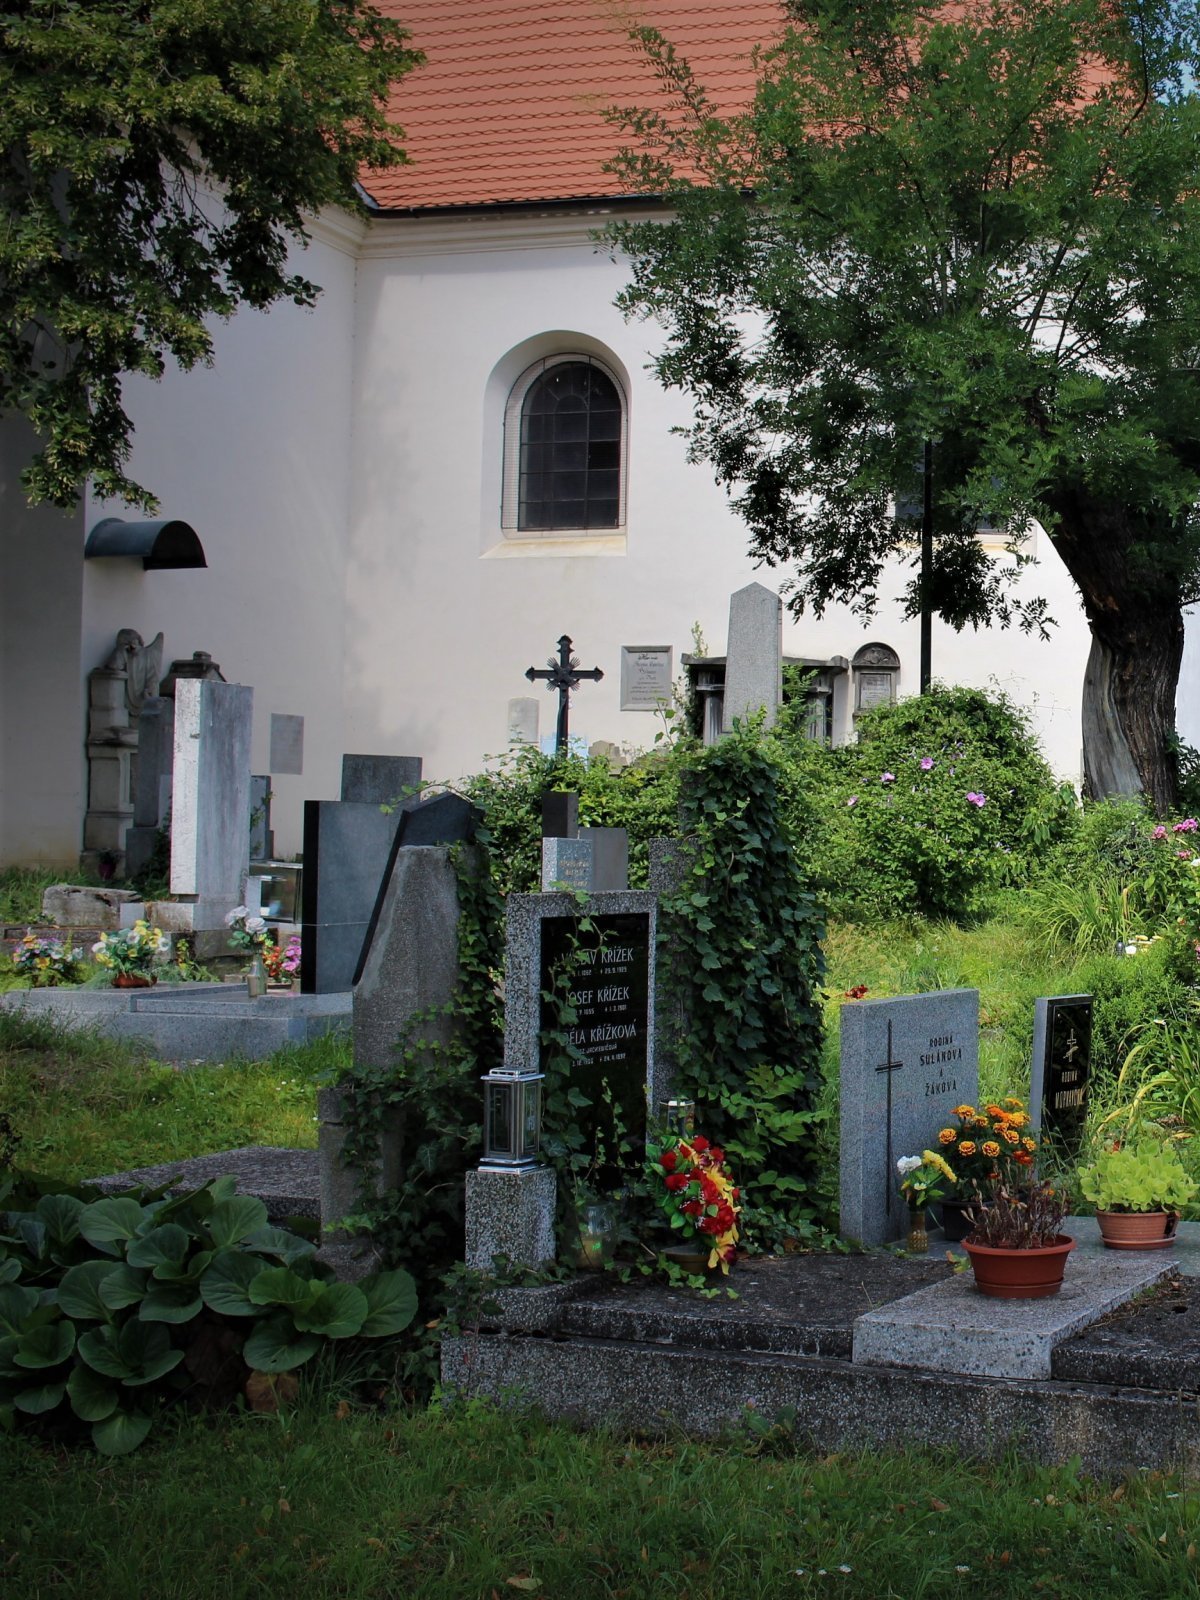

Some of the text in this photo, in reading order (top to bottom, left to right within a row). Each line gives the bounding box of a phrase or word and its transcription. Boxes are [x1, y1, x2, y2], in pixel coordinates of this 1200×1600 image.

[601, 946, 634, 964] KŘÍŽEK
[597, 984, 630, 1003] KŘÍŽEK
[590, 1018, 637, 1043] KŘÍŽKOVÁ
[929, 1035, 953, 1048] RODINA
